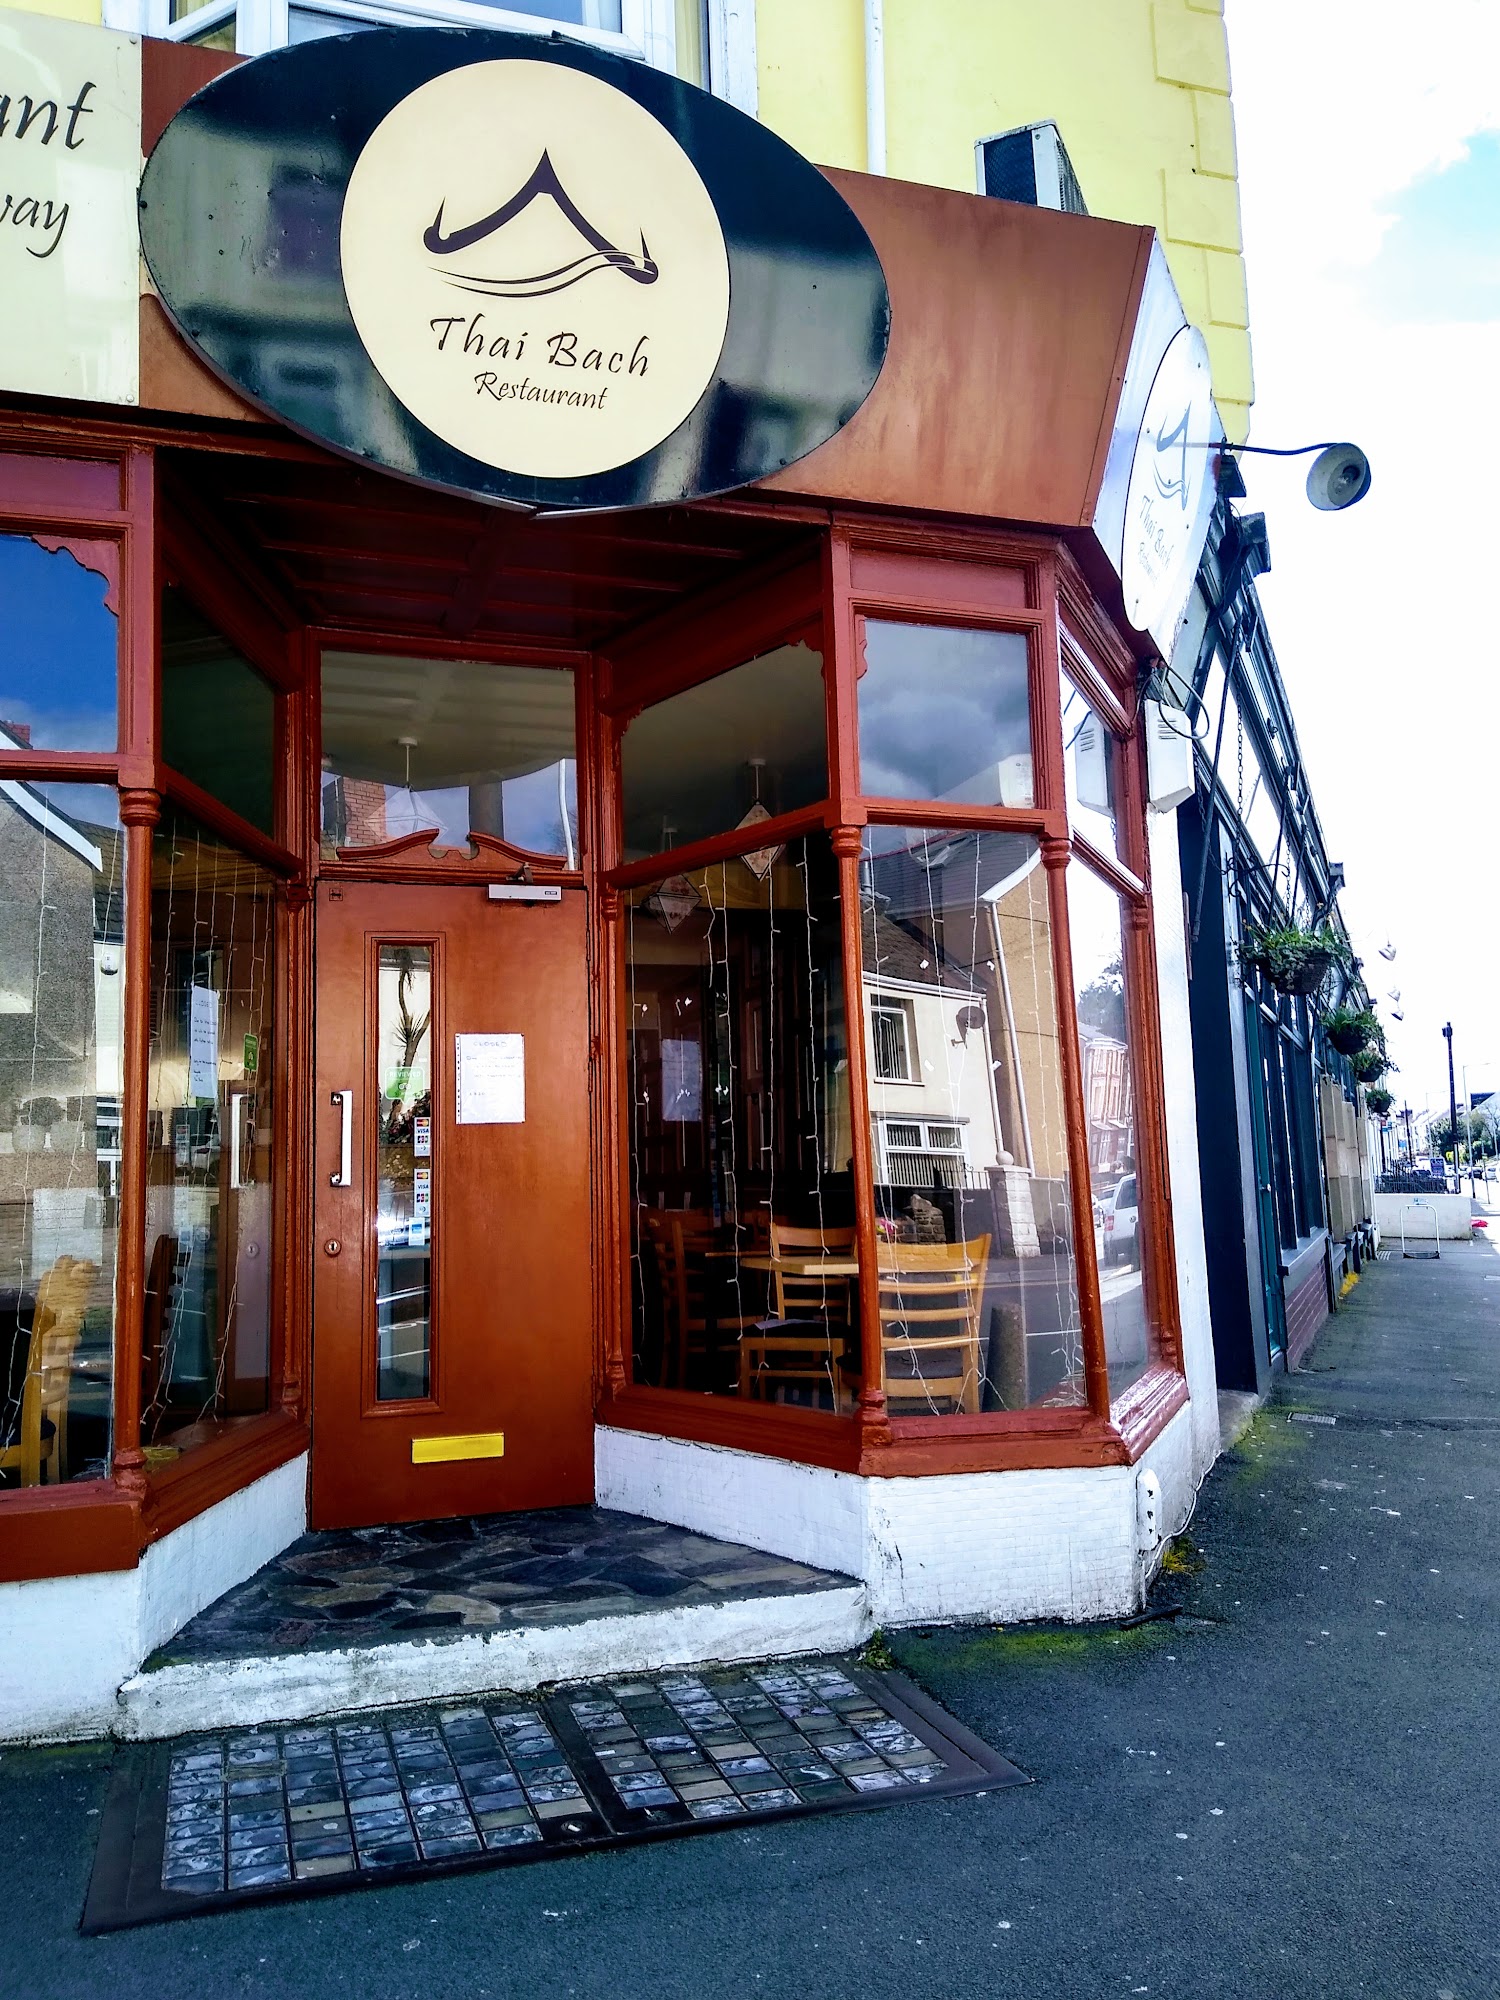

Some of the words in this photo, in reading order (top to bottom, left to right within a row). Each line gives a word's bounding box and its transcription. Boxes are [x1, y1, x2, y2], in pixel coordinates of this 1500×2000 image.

[430, 313, 529, 361] Thai
[546, 331, 650, 377] Bach
[474, 371, 608, 410] Restaurant
[1139, 494, 1158, 539] Thai
